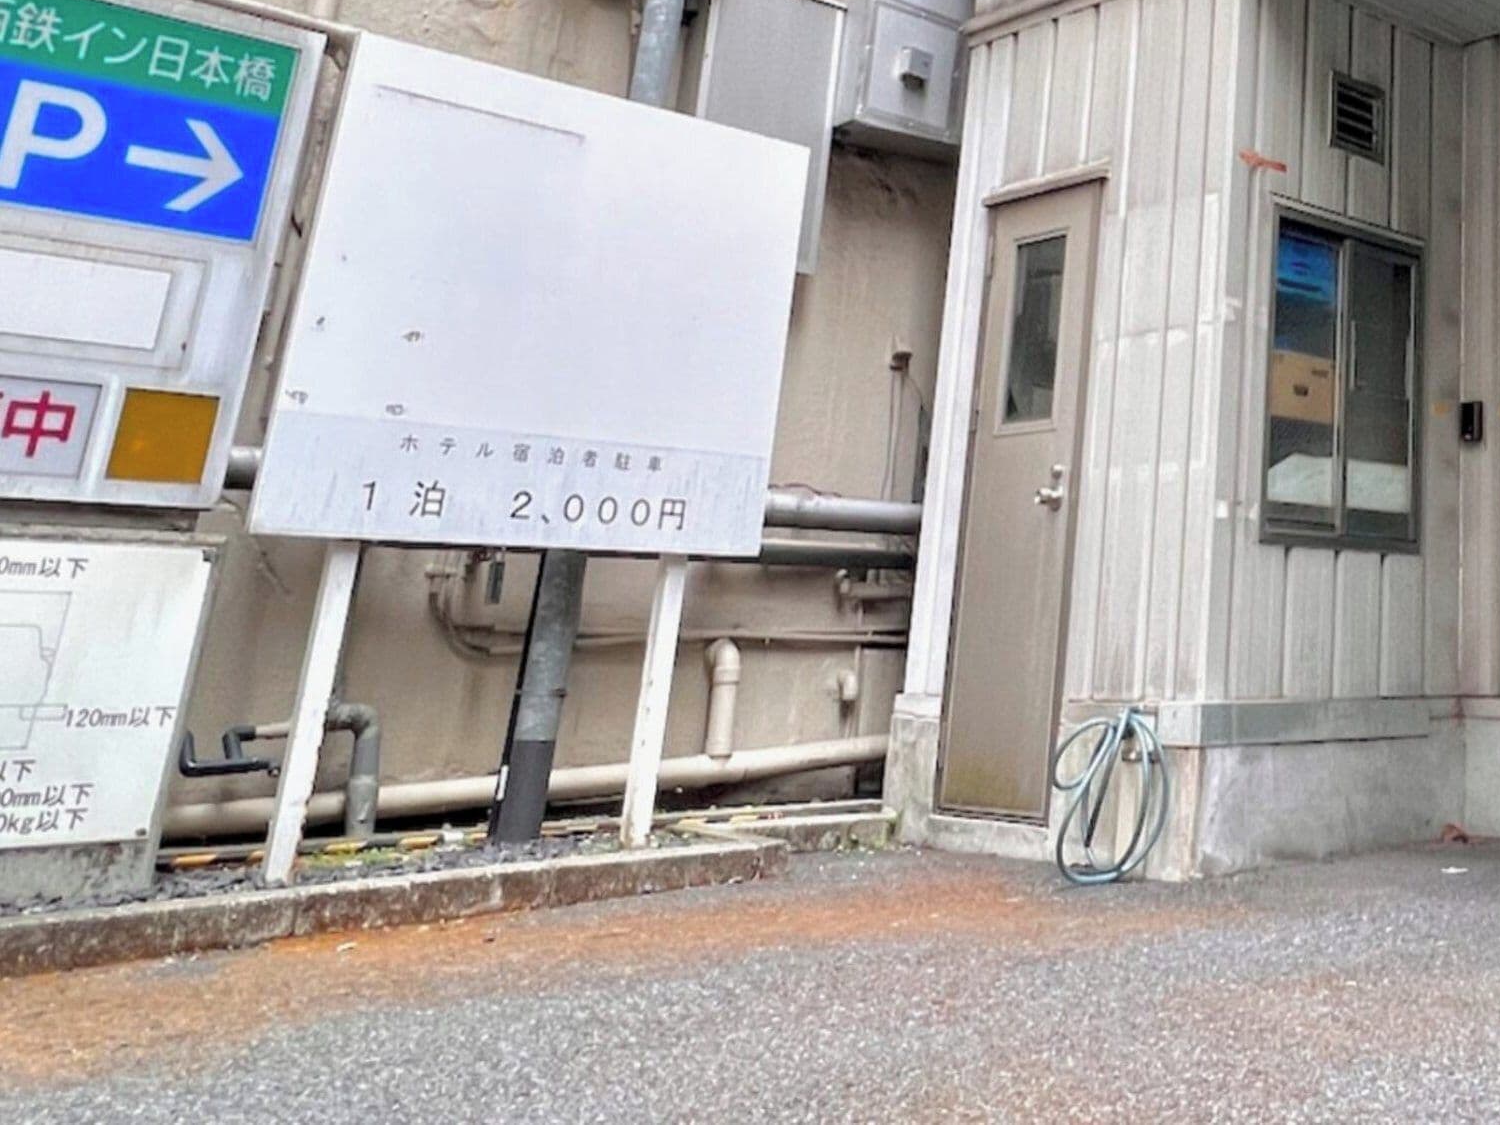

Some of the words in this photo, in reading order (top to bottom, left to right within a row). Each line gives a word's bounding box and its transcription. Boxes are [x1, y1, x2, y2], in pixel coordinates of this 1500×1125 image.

[0, 78, 108, 190] P
[0, 389, 76, 458] 中
[66, 705, 177, 728] 120mm以下
